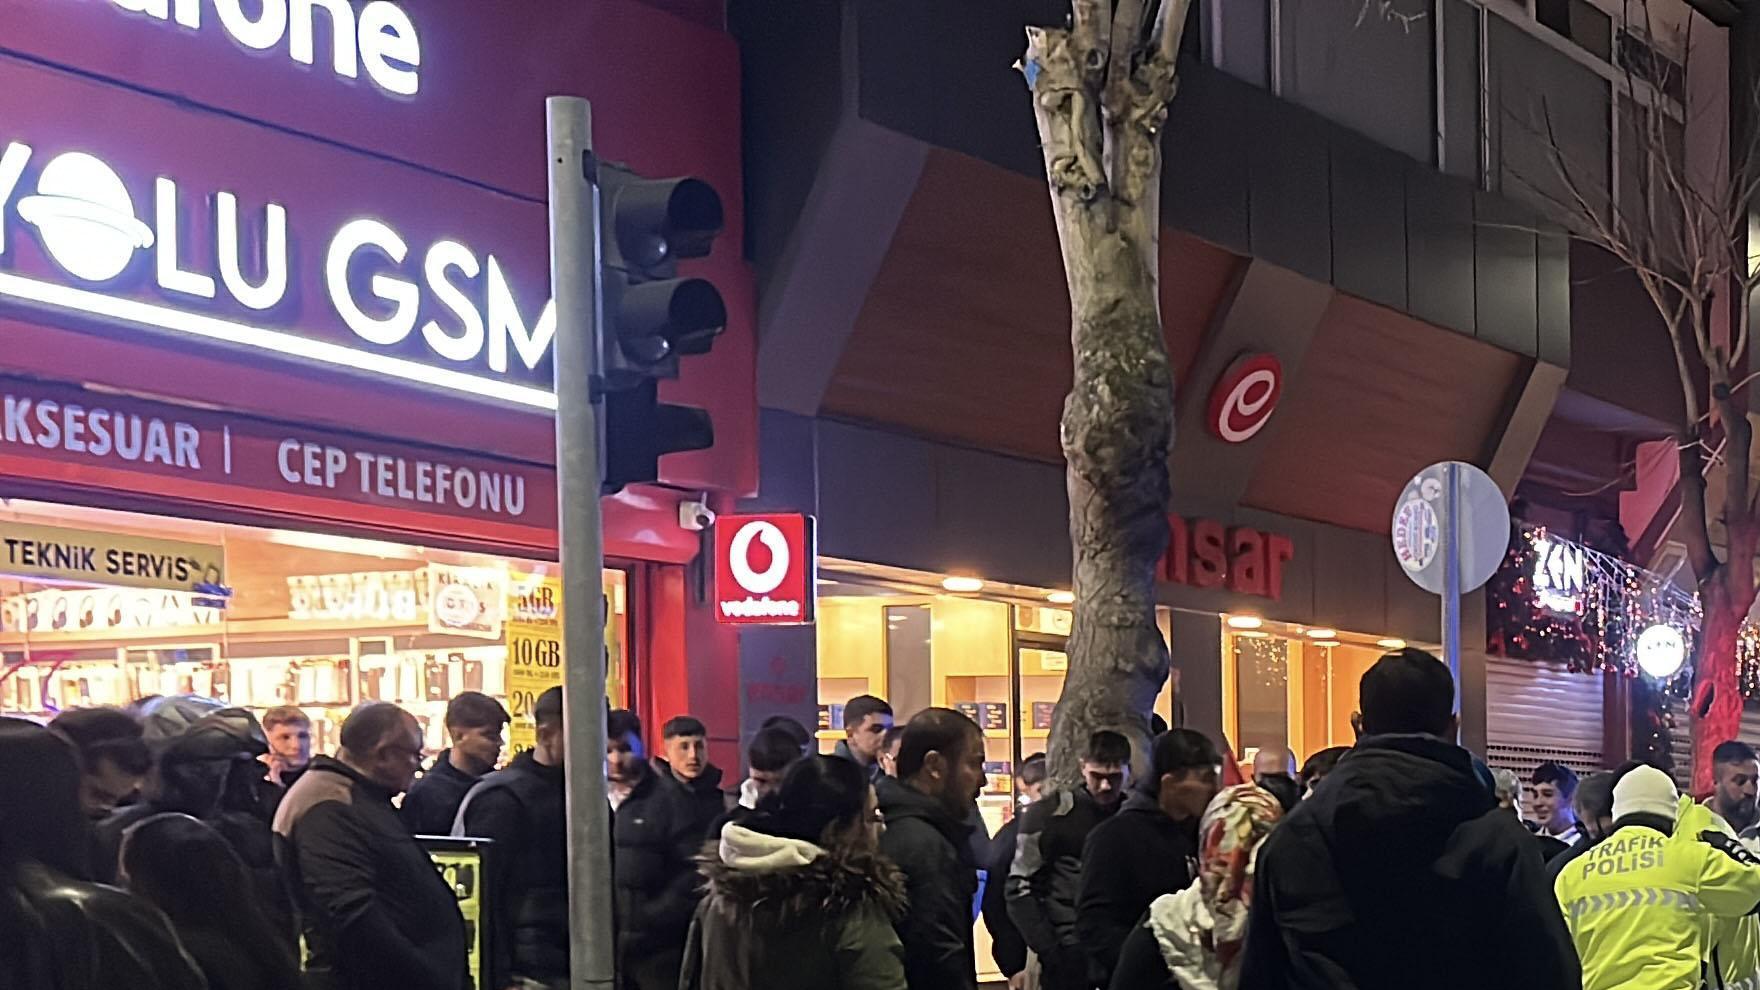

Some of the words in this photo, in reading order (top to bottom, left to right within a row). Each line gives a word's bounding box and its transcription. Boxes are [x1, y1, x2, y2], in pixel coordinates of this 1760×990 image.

[327, 218, 557, 372] GSM
[0, 395, 201, 469] KSESUAR
[278, 438, 347, 489] CEP
[356, 452, 526, 516] TELEFONU
[1533, 539, 1582, 592] ZEN
